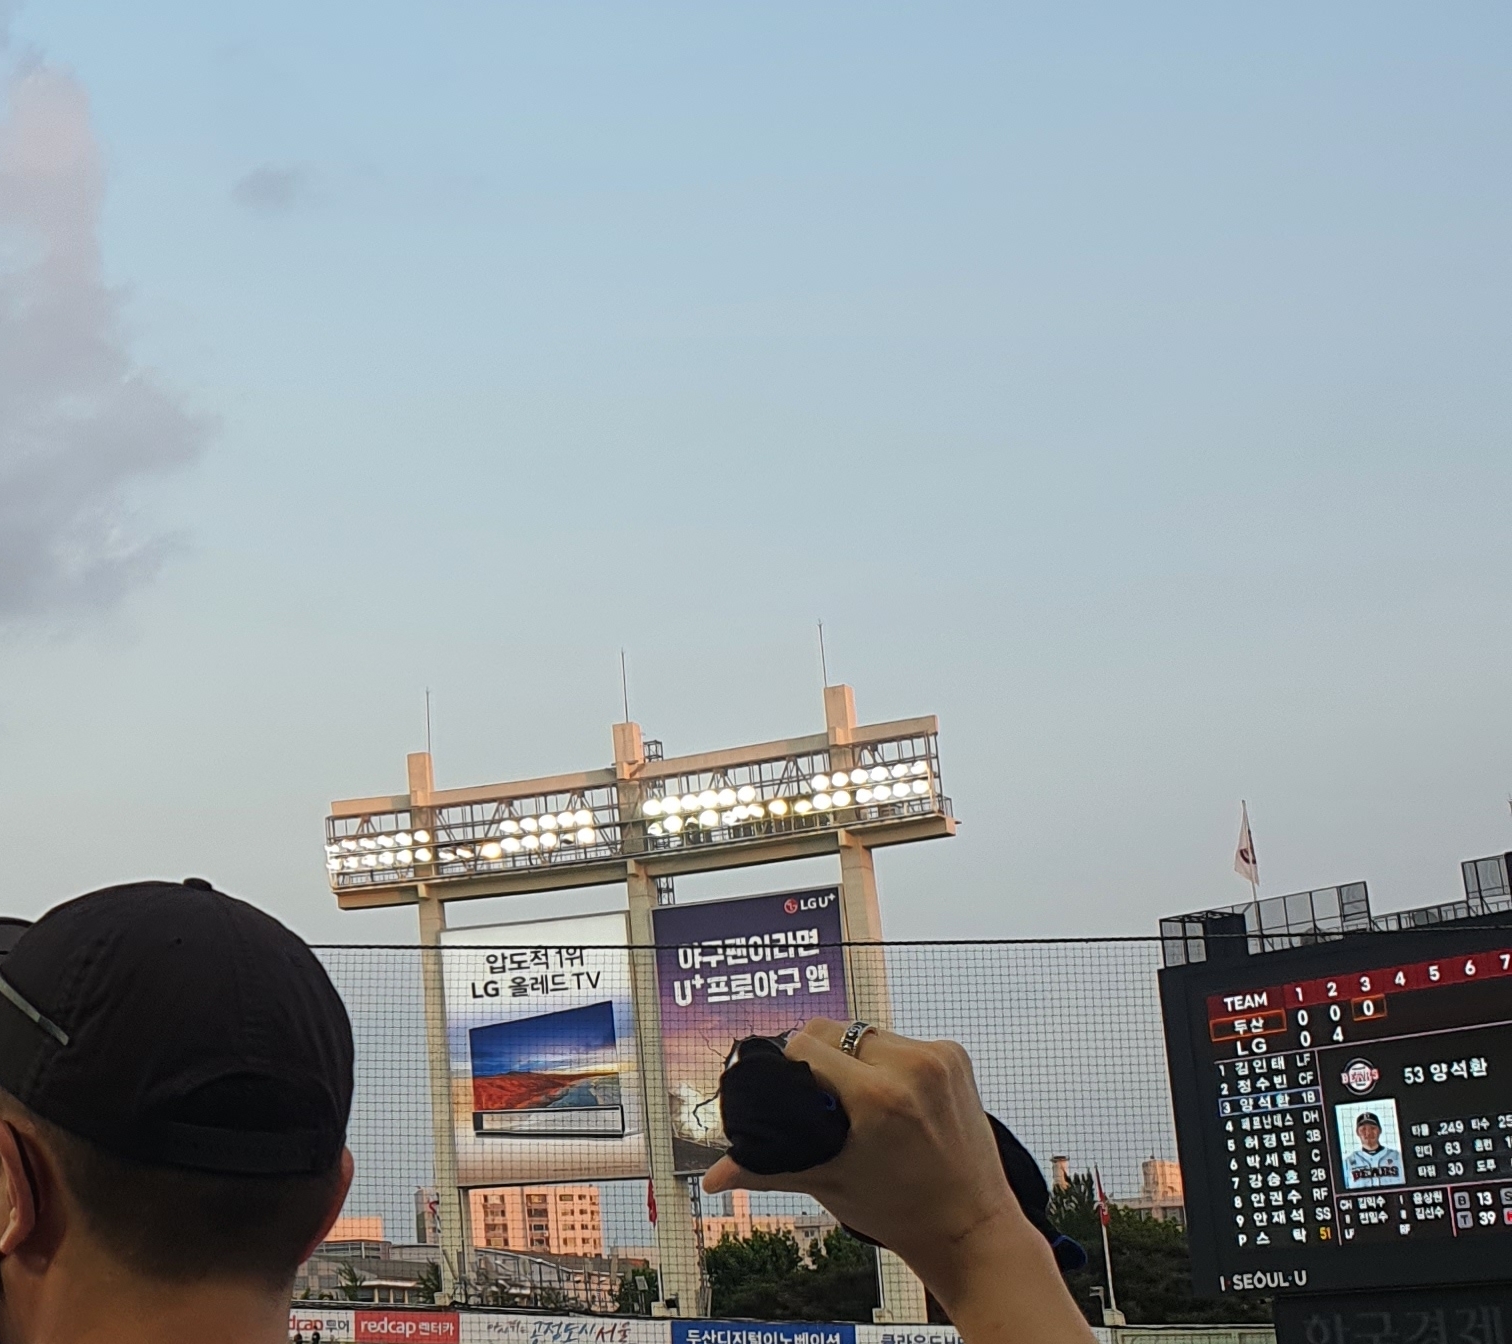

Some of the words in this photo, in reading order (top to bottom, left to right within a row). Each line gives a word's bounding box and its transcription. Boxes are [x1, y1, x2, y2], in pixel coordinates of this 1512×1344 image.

[800, 899, 817, 911] LG
[486, 946, 549, 974] 압도적
[555, 946, 584, 968] 1위
[677, 928, 820, 969] 야구팬이라면
[471, 980, 500, 999] LG
[508, 974, 569, 997] 올레드
[571, 971, 601, 990] TV
[805, 964, 831, 994] 앱
[1224, 992, 1268, 1012] TEAM
[1296, 987, 1304, 1002] 1
[1327, 982, 1338, 997] 2
[1360, 976, 1371, 992] 3
[1395, 971, 1406, 986] 4
[1429, 965, 1440, 981] 5
[1465, 960, 1476, 976] 6
[1500, 954, 1511, 970] 7
[1234, 1017, 1265, 1036] 두산
[1298, 1010, 1308, 1026] 0
[1330, 1005, 1341, 1022] 0
[1363, 1000, 1374, 1016] 0
[1237, 1038, 1268, 1056] LG
[1300, 1031, 1311, 1047] 0
[1332, 1025, 1344, 1043] 4
[1219, 1065, 1225, 1076] 1
[1235, 1056, 1286, 1076] 김인태
[1296, 1053, 1311, 1067] LF
[1403, 1067, 1424, 1084] 53
[1429, 1057, 1488, 1082] 양석환
[1220, 1083, 1229, 1095] 2
[1237, 1073, 1288, 1093] 정수빈
[1298, 1071, 1314, 1085] CF
[1223, 1102, 1231, 1114] 3
[1301, 1090, 1316, 1103] 1B
[1225, 1120, 1234, 1132] 4
[1302, 1110, 1320, 1124] DH
[1437, 1120, 1464, 1136] .249
[1227, 1139, 1236, 1152] 5
[1244, 1130, 1296, 1150] 허경민
[1305, 1129, 1322, 1143] 3B
[1229, 1157, 1238, 1171] 6
[1246, 1150, 1297, 1169] 박세혁
[1311, 1148, 1321, 1163] C
[1447, 1161, 1464, 1176] 30
[1231, 1177, 1240, 1190] 7
[1248, 1169, 1300, 1188] 강승호
[1310, 1168, 1327, 1182] 2B
[1234, 1195, 1243, 1209] 8
[1250, 1189, 1303, 1208] 안권수
[1312, 1187, 1329, 1201] RF
[1476, 1191, 1493, 1206] 13
[1235, 1214, 1245, 1228] 9
[1253, 1208, 1305, 1227] 안재석
[1315, 1206, 1332, 1221] SS
[1478, 1210, 1497, 1226] 39
[1237, 1233, 1247, 1247] P
[1319, 1226, 1332, 1240] 51
[361, 1320, 416, 1338] redcap
[419, 1322, 455, 1336] 렌터카
